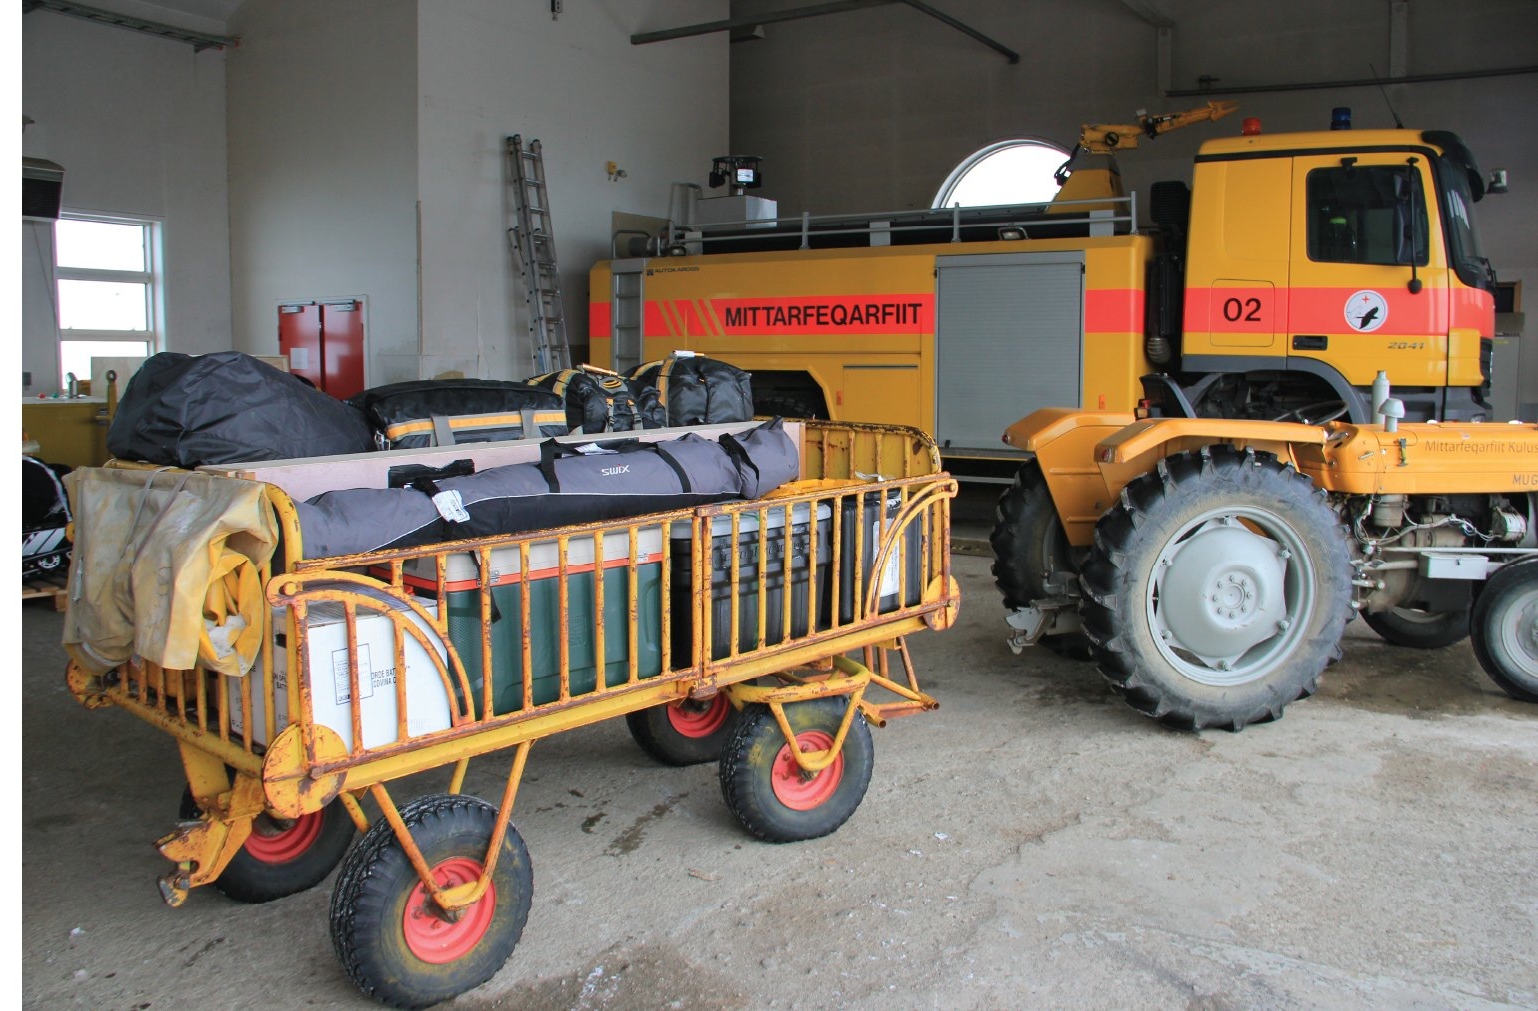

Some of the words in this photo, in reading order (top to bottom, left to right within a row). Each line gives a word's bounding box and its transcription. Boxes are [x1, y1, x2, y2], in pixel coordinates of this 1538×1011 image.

[724, 303, 923, 327] MITTARFEQARFIIT
[1222, 297, 1262, 322] 02
[1424, 440, 1505, 455] Mittarfeqarfiit
